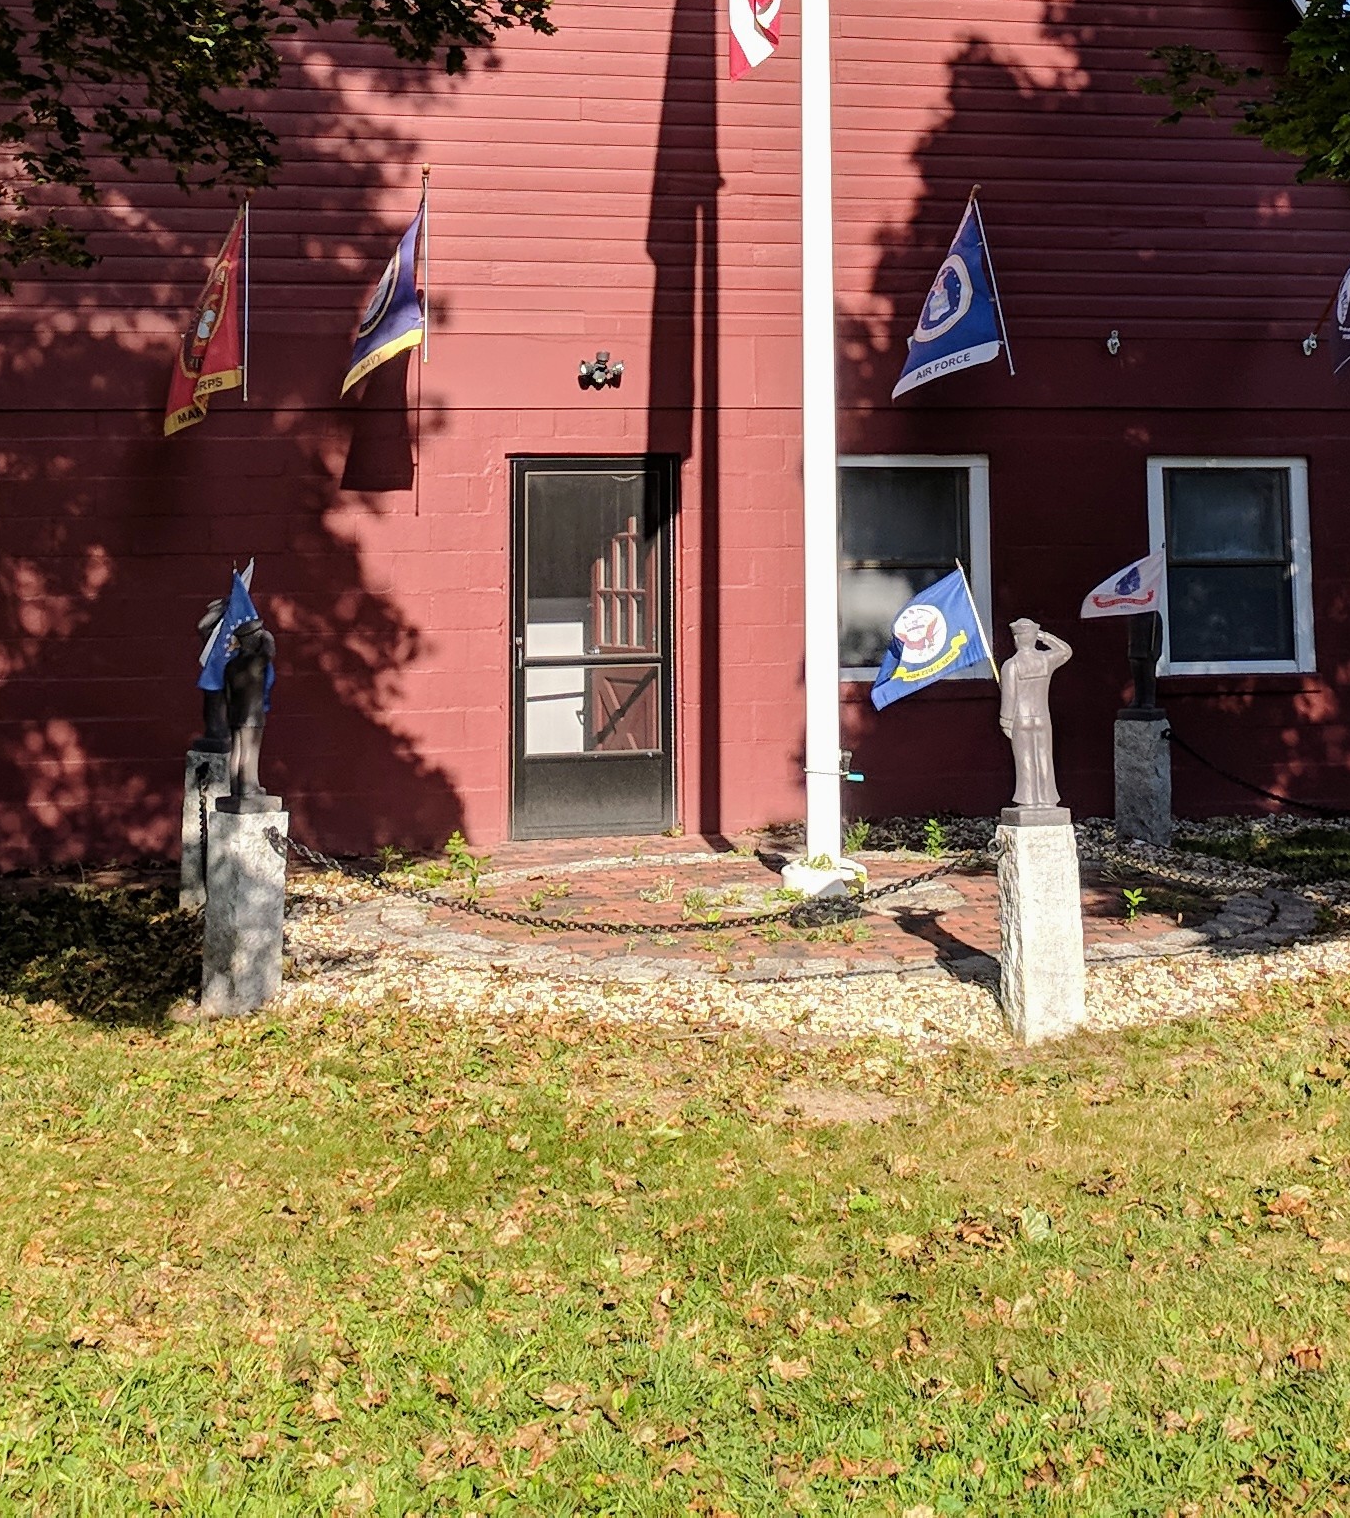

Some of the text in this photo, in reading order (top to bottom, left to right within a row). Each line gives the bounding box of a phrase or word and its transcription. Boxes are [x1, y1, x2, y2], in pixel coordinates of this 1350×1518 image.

[359, 351, 383, 373] NAVY
[915, 352, 971, 381] AIR FORCE
